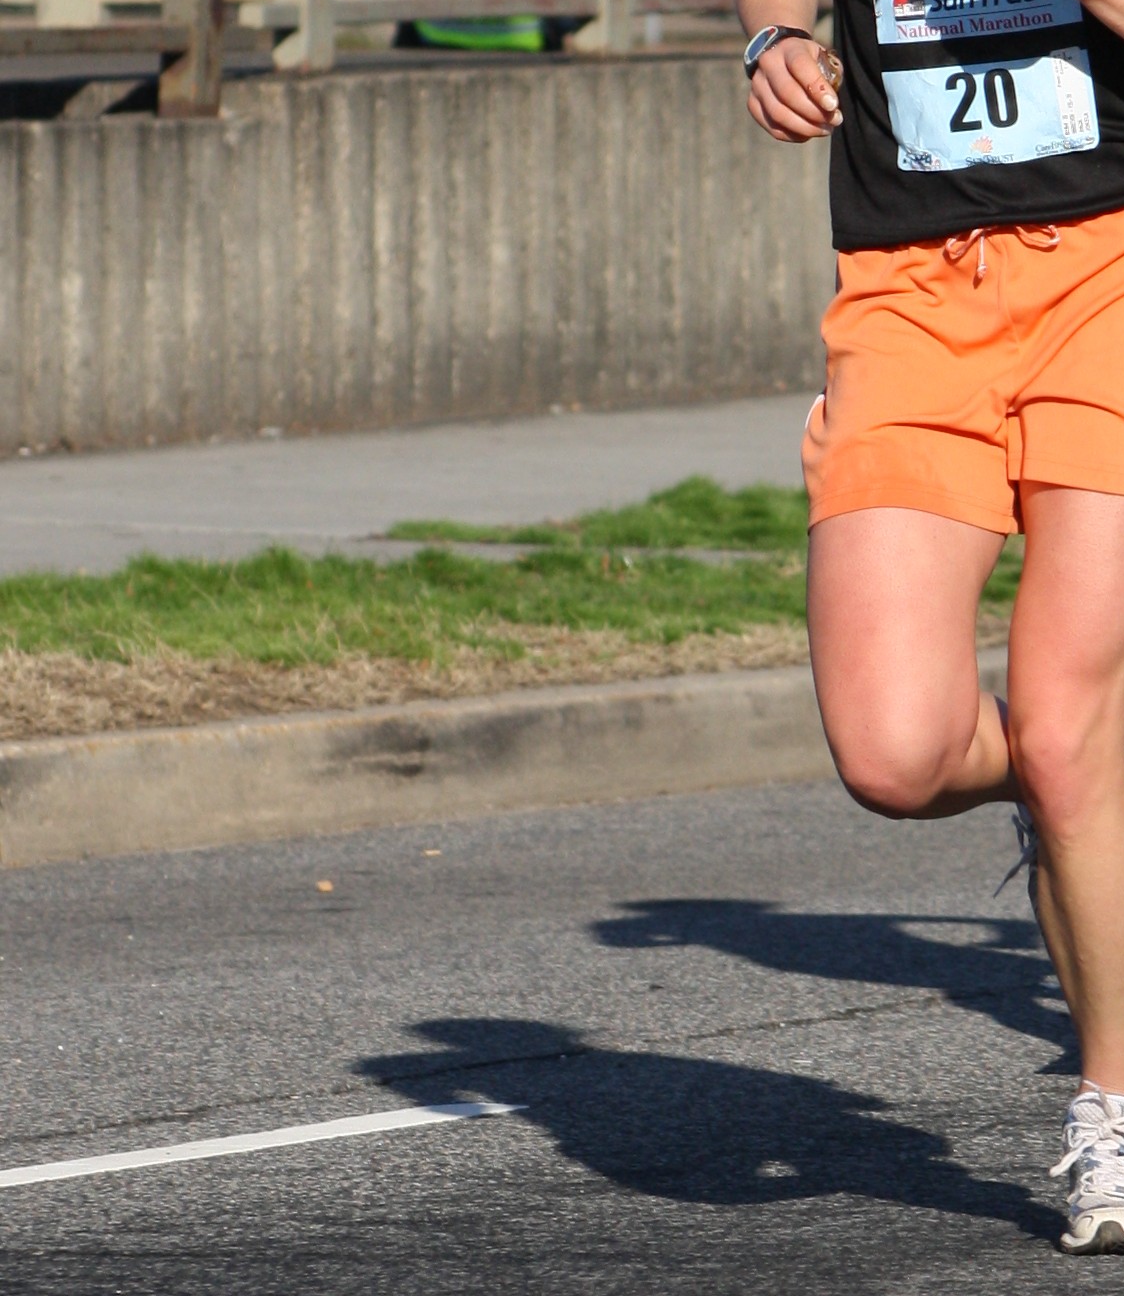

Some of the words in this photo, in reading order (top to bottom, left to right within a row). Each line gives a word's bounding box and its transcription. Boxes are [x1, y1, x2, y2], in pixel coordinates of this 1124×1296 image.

[897, 20, 965, 39] National
[970, 11, 1053, 32] Marathon
[945, 68, 1019, 132] 20
